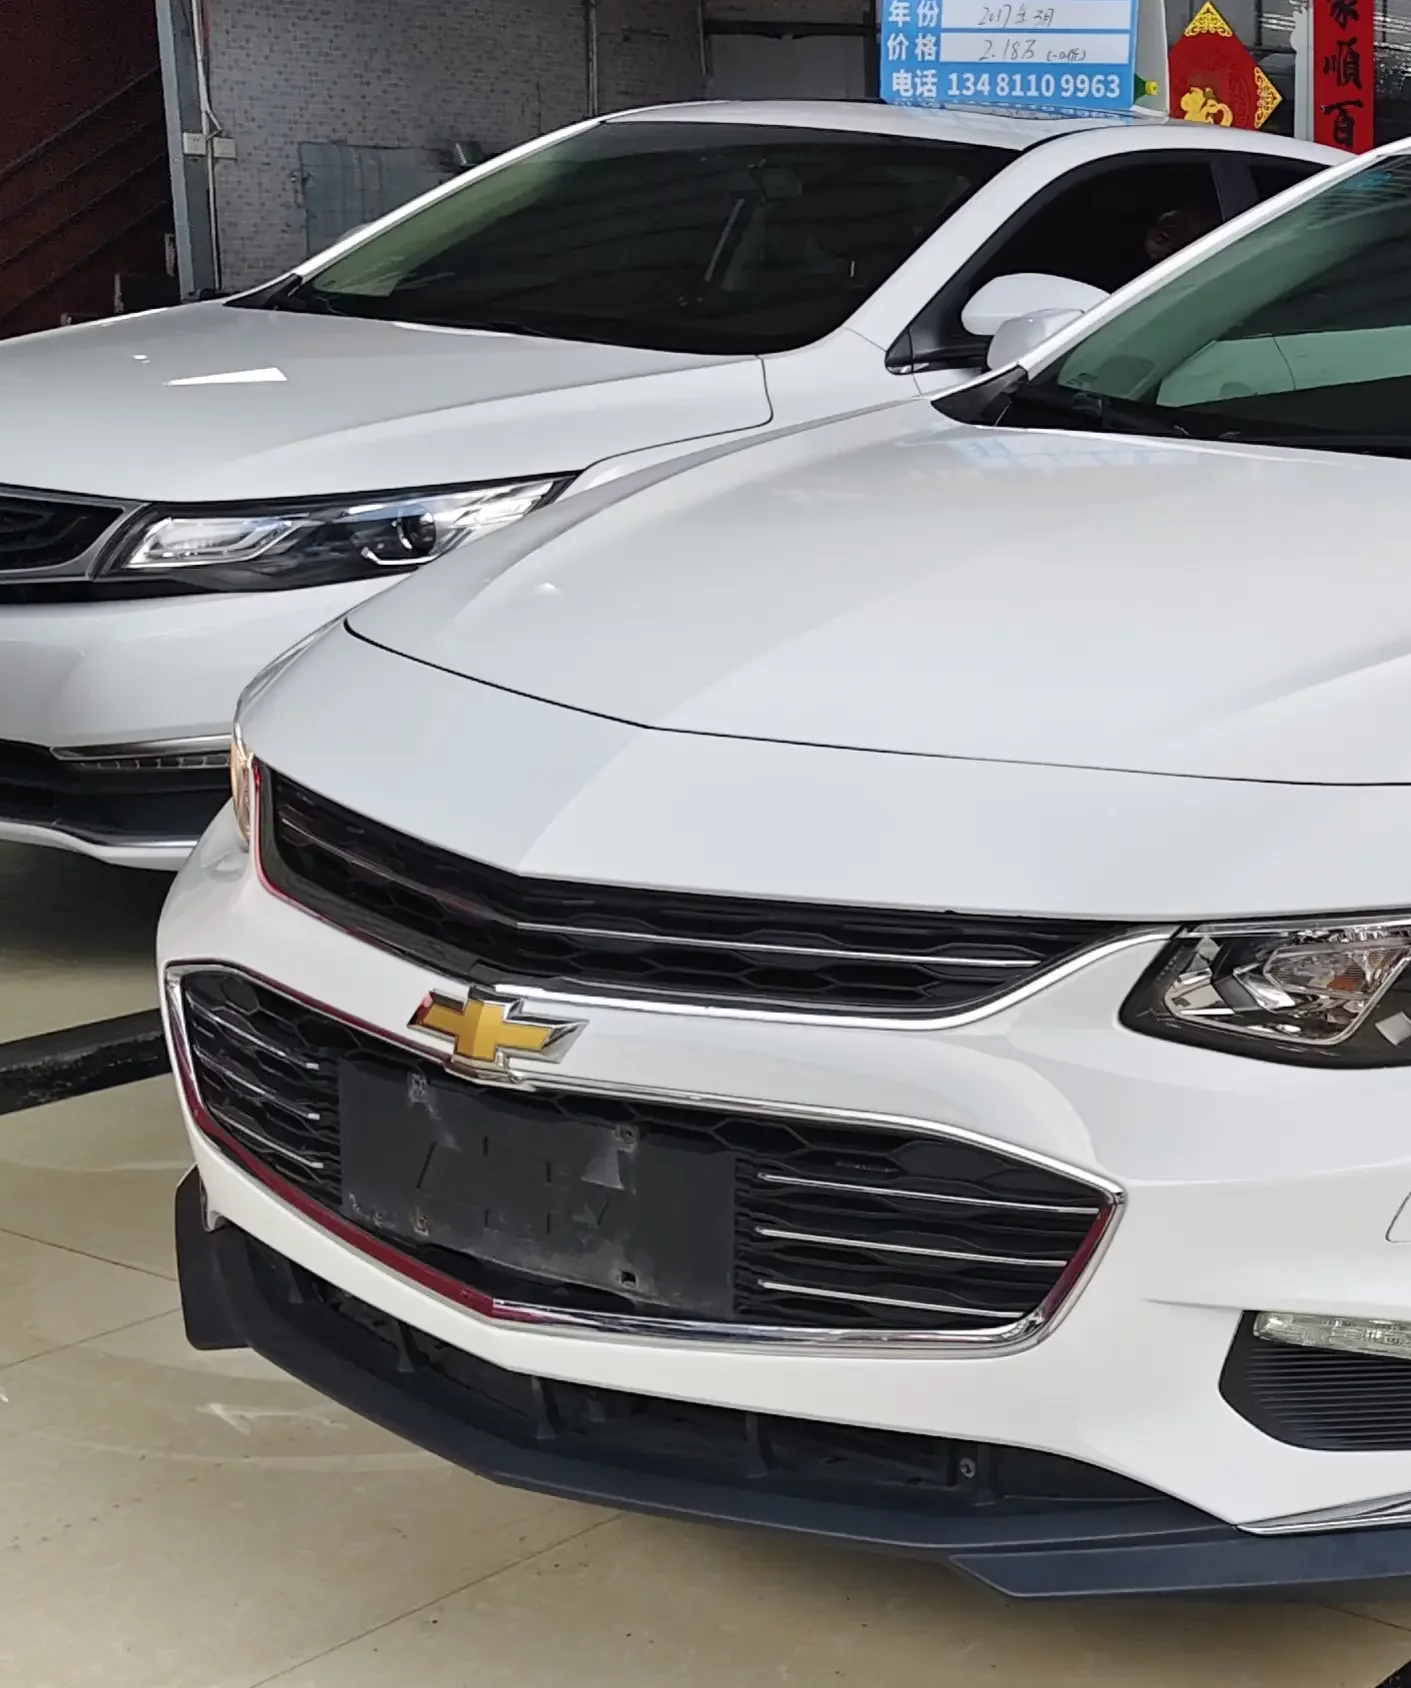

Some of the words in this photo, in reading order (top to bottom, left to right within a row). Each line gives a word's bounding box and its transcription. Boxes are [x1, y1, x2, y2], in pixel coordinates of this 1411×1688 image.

[888, 0, 939, 28] 年份
[887, 33, 938, 61] 价格
[892, 69, 938, 99] 电话
[948, 73, 990, 97] 134
[996, 73, 1055, 97] 8110
[1060, 74, 1121, 98] 9963
